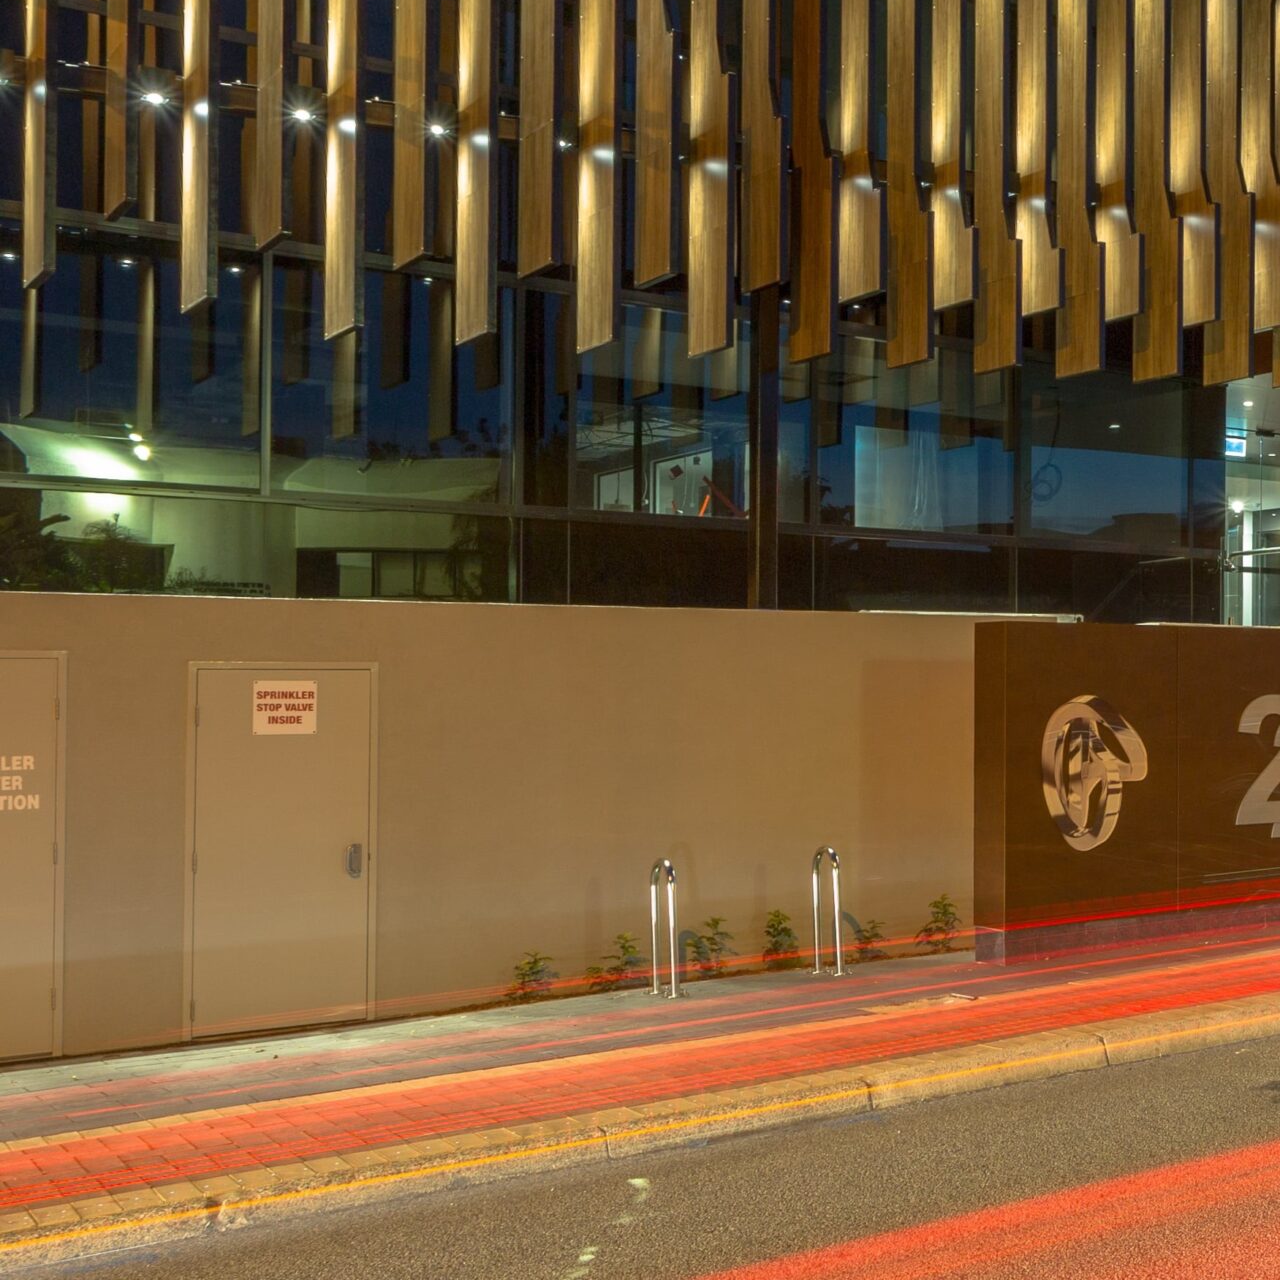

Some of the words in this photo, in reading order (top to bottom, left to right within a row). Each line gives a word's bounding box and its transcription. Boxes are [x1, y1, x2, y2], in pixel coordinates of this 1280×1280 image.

[256, 690, 315, 700] SPRINKLER
[256, 703, 282, 712] STOP
[284, 703, 314, 712] VALVE
[267, 715, 303, 725] INSIDE
